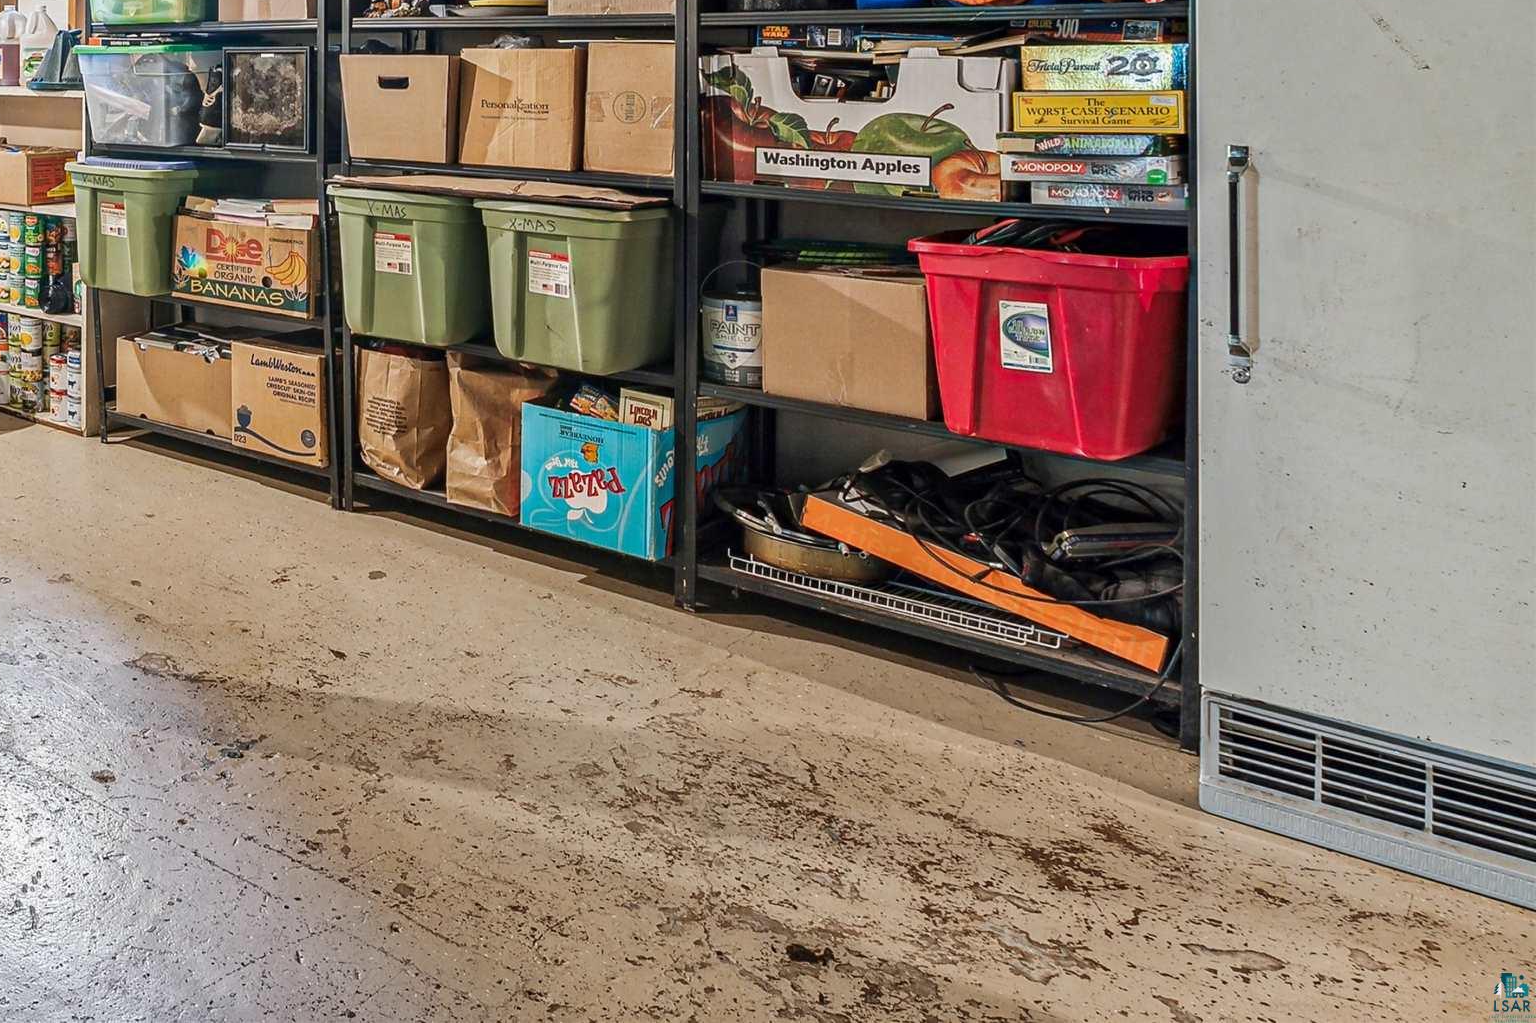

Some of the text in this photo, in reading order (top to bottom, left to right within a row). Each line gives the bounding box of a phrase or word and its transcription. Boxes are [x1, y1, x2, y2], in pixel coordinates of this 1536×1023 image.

[1086, 97, 1105, 107] The
[1027, 106, 1170, 116] WORST-CASE SCENARIO
[1060, 116, 1132, 125] Survival Game
[1036, 138, 1061, 152] WILD
[763, 151, 922, 176] Washington Apples
[1016, 163, 1083, 173] MONOPOLY
[1050, 188, 1120, 199] MONOPOLY
[367, 200, 408, 218] X-MAS
[510, 218, 556, 233] X-MAS
[206, 228, 263, 259] Doe
[216, 263, 253, 274] CERTIFIED
[214, 270, 257, 284] ORGANIC
[190, 279, 284, 306] BANANAS
[710, 319, 761, 336] PAINT
[715, 332, 751, 342] SHIELD
[273, 390, 298, 401] ORIGINAL
[298, 394, 316, 405] RECIPE
[629, 403, 658, 420] LINCOLN
[634, 413, 652, 427] LOGS
[560, 431, 605, 444] HONEYBEAR
